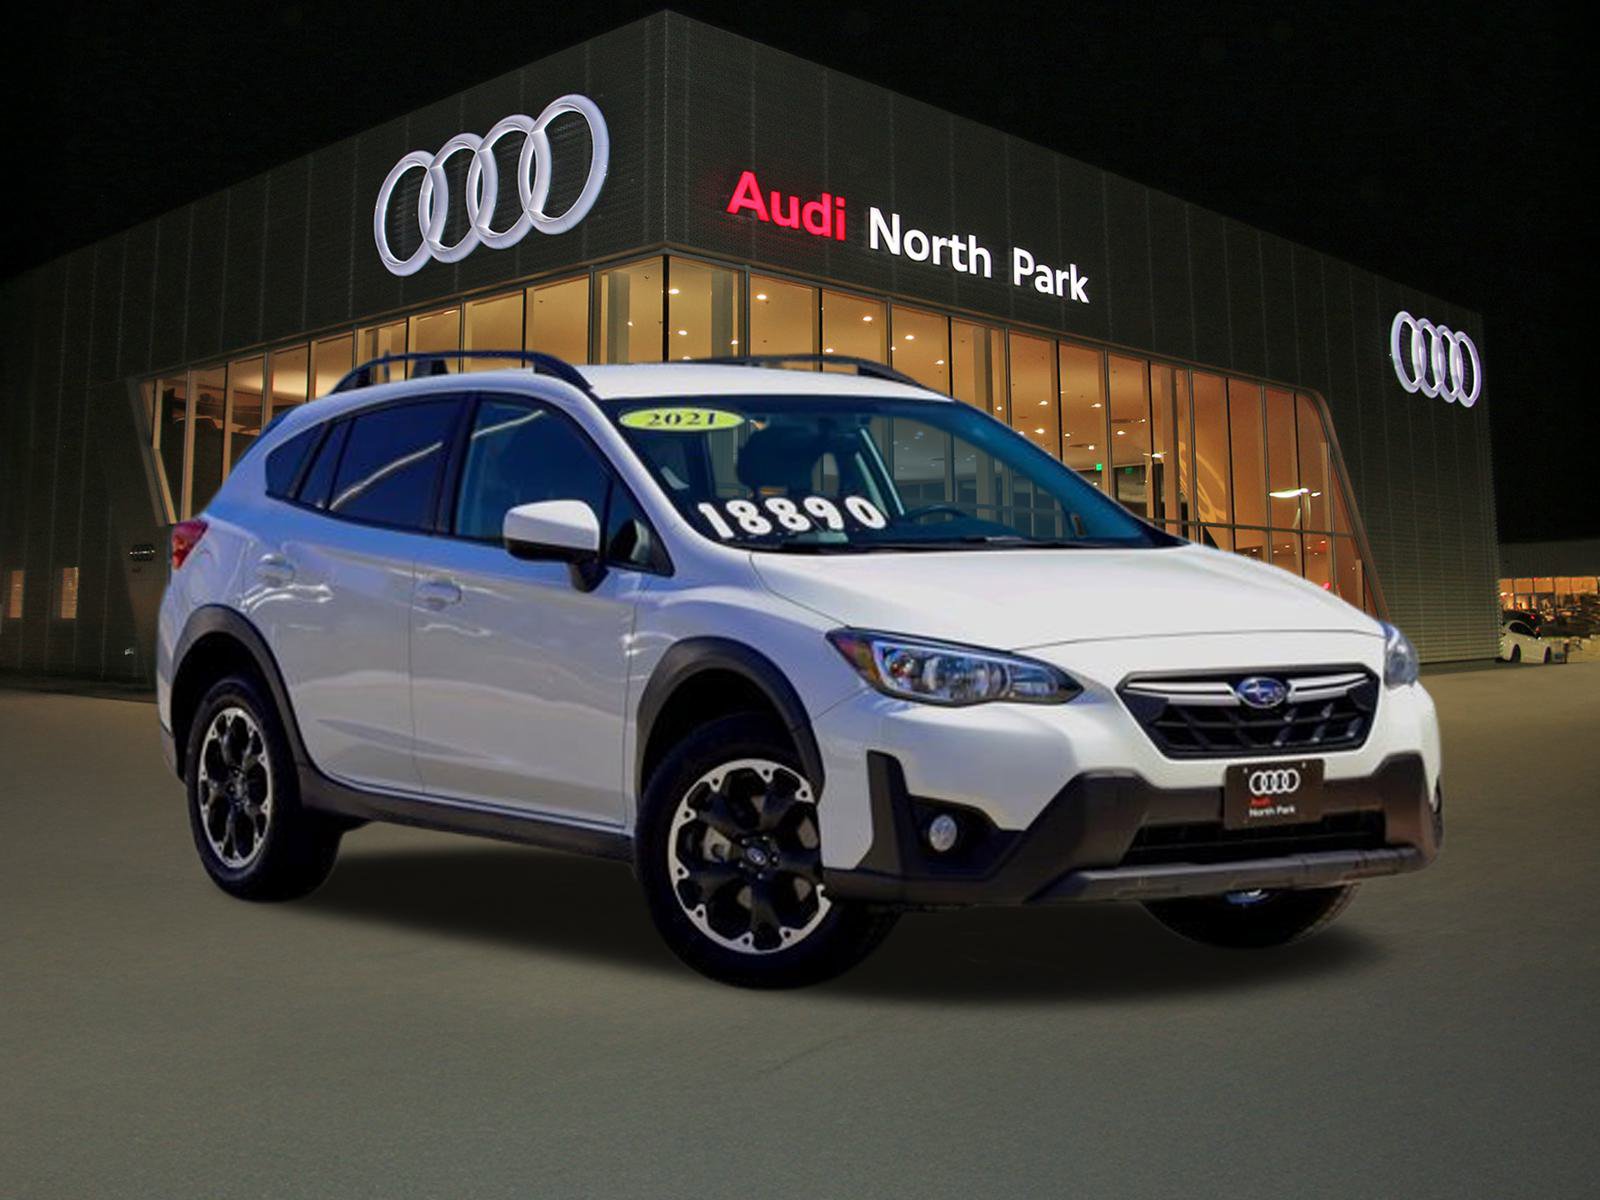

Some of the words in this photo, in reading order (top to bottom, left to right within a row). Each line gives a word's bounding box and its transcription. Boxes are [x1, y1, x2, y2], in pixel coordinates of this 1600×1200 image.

[726, 171, 846, 240] Audi
[869, 207, 992, 278] North
[1013, 247, 1090, 303] Park
[648, 412, 716, 426] 2021
[698, 496, 886, 538] 18890
